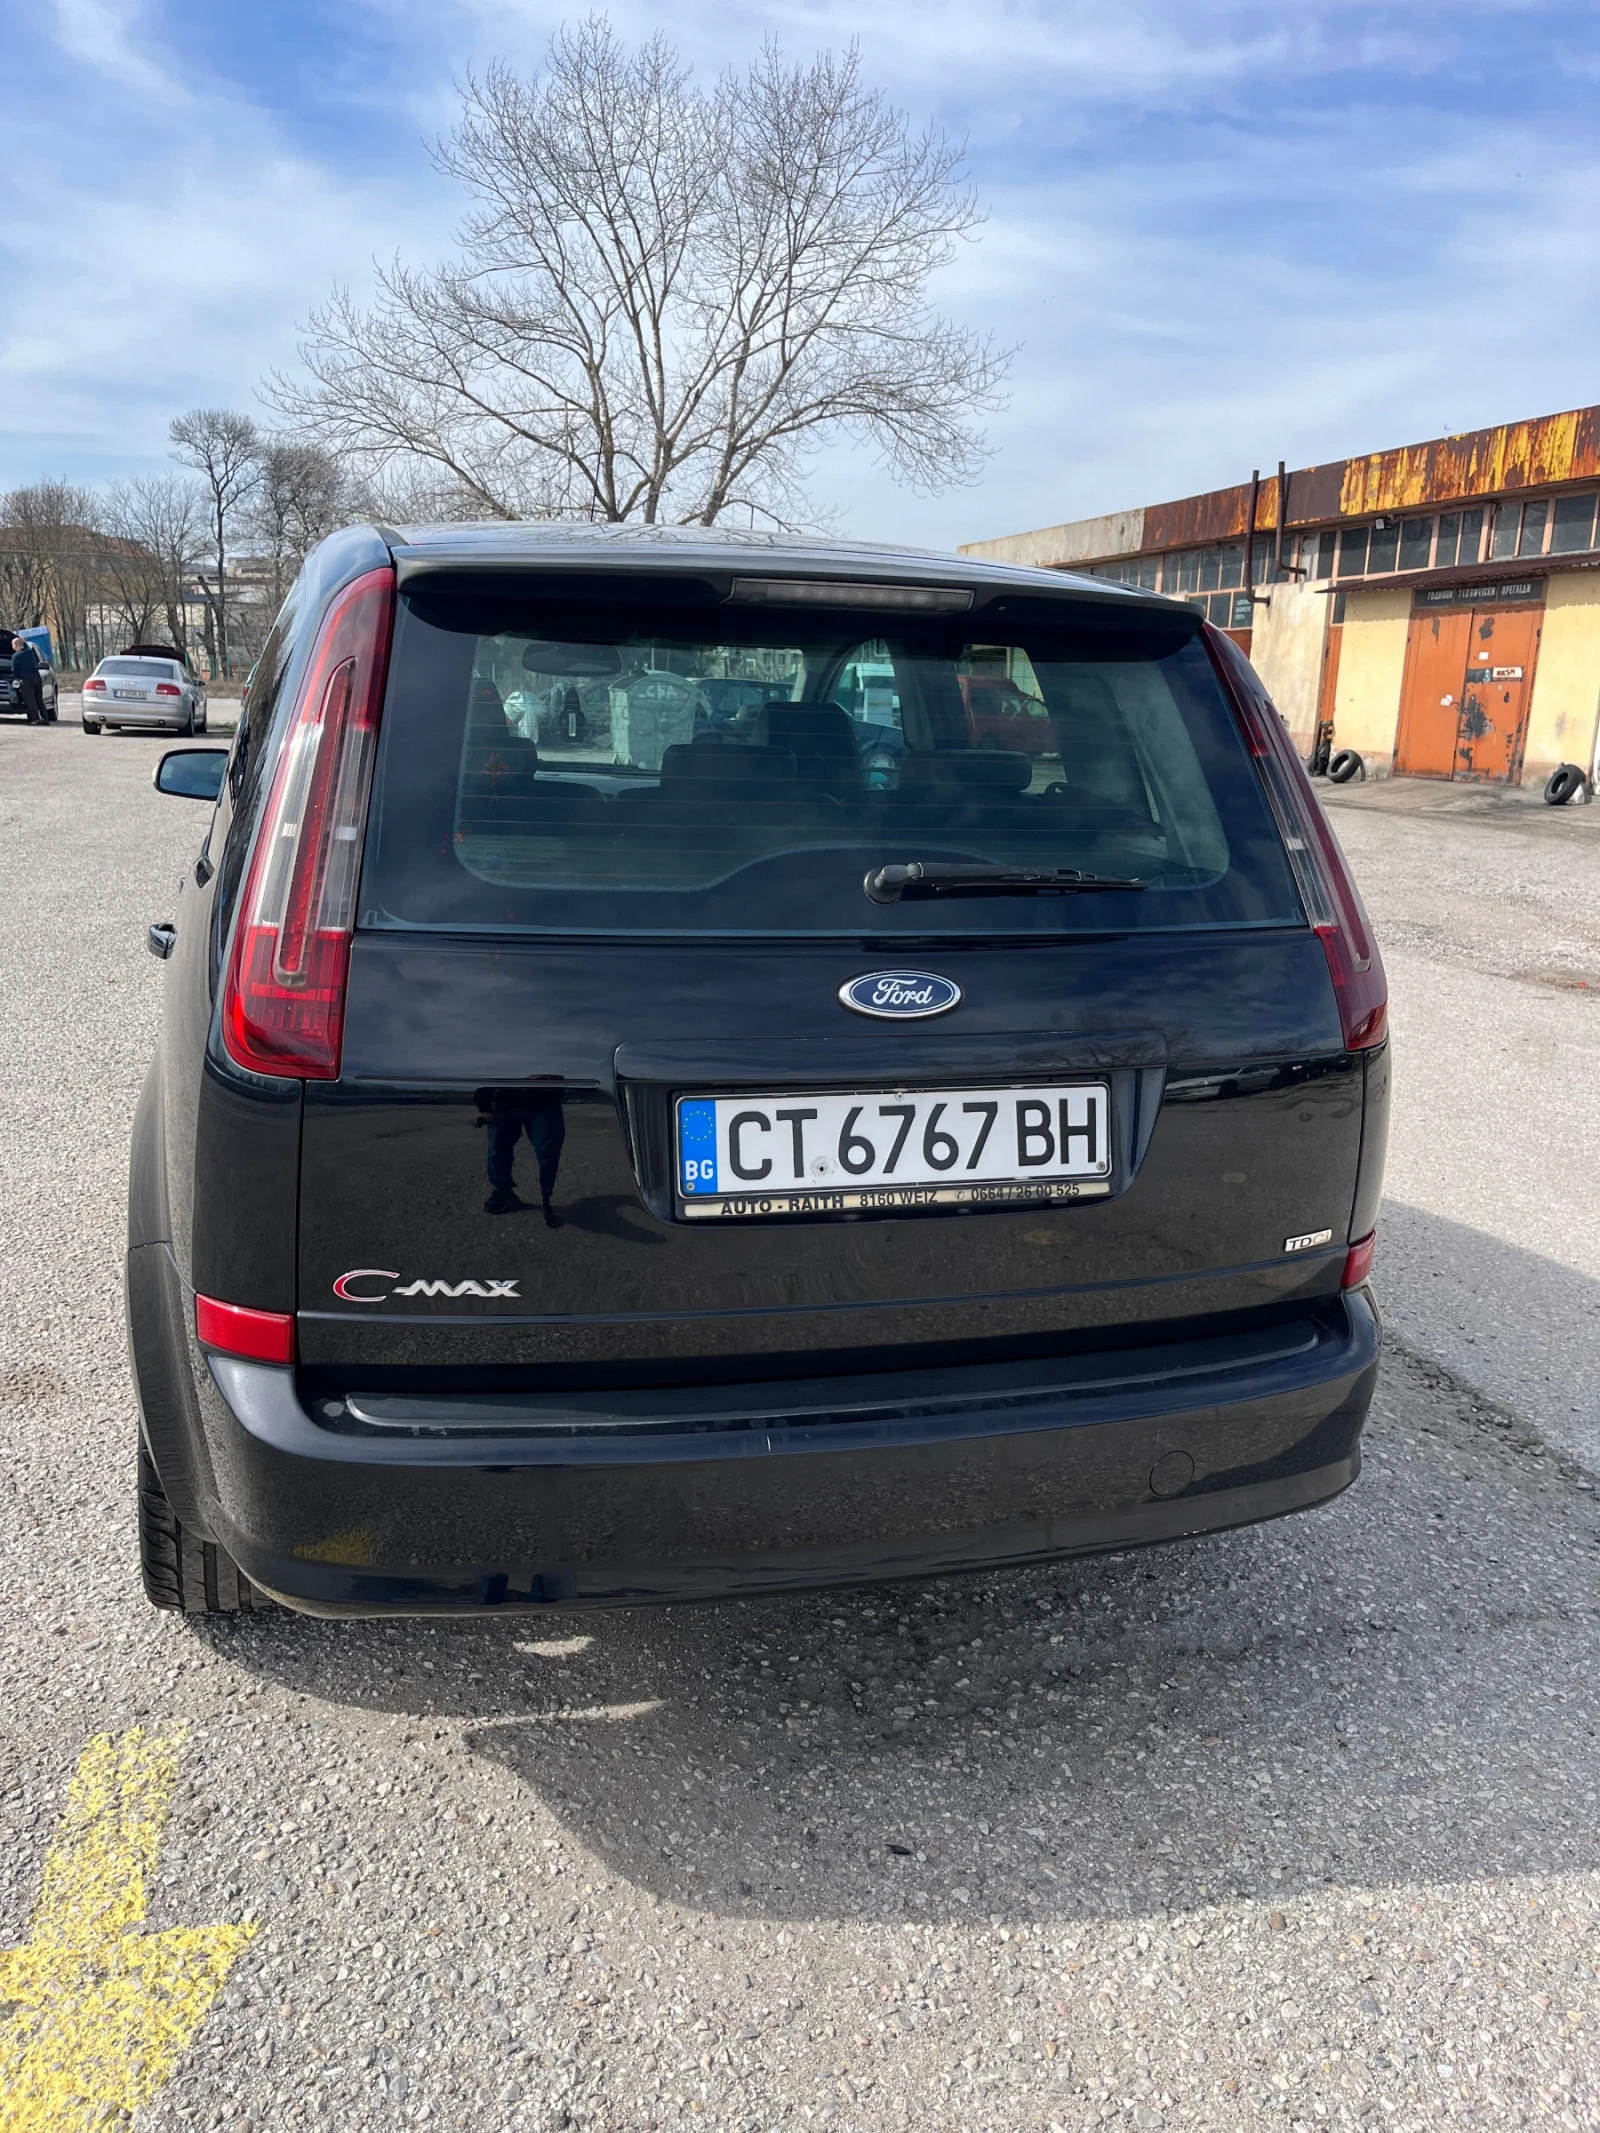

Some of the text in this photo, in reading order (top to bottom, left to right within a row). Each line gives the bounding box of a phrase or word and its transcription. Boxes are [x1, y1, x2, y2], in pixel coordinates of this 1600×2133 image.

[1458, 586, 1496, 598] ТЕХНИЧЕСКИ
[1501, 583, 1532, 595] ПРЕГЛЕДИ
[872, 978, 933, 1005] Ford
[838, 1101, 998, 1175] 6767
[685, 1160, 714, 1181] BG
[720, 1200, 773, 1216] AUTO
[788, 1195, 845, 1212] RAITH
[859, 1192, 896, 1208] 8160
[900, 1190, 939, 1205] WEIZ
[971, 1187, 1002, 1201] 0664
[1015, 1185, 1033, 1199] 26
[1036, 1184, 1052, 1198] 00
[1055, 1183, 1080, 1196] 525
[1288, 1231, 1330, 1250] TDCi
